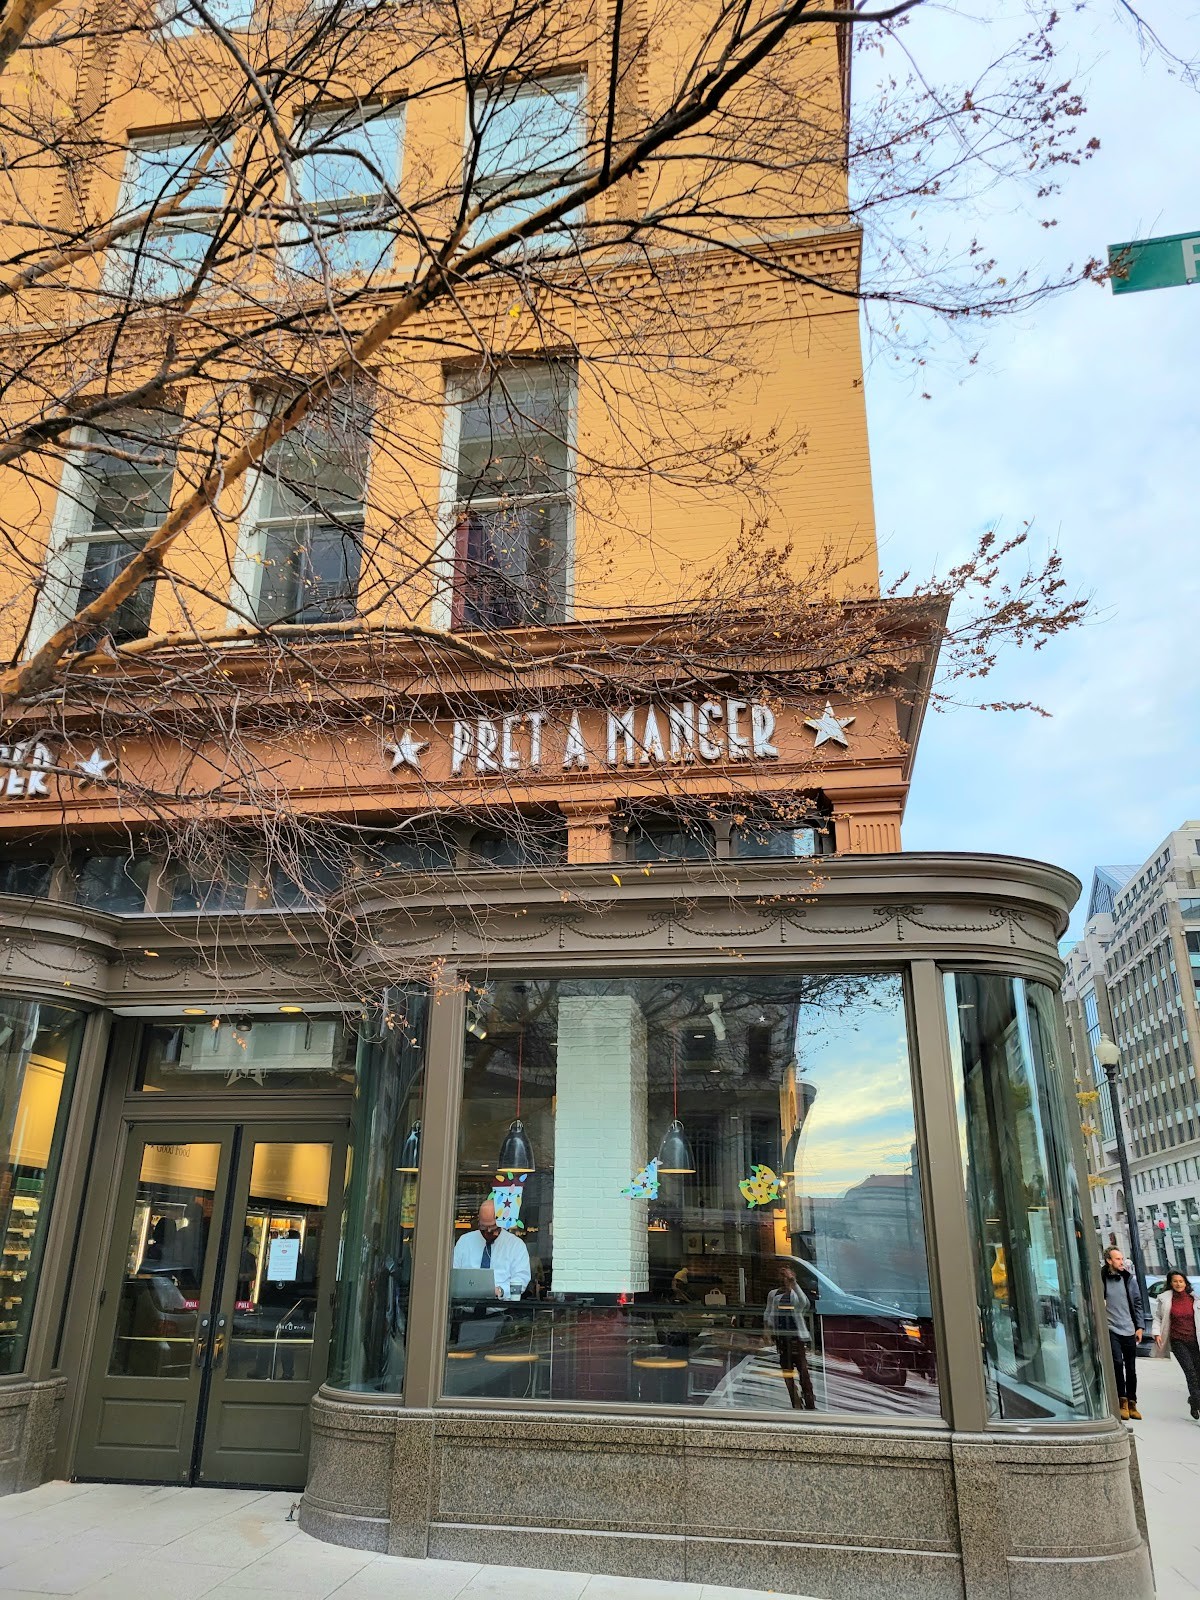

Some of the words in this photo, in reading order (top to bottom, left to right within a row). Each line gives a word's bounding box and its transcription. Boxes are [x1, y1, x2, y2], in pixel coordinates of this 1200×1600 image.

[450, 709, 547, 777] PRET
[562, 708, 589, 771] A
[606, 697, 779, 766] MANGER
[185, 1301, 198, 1309] PULL
[237, 1302, 250, 1310] PULL
